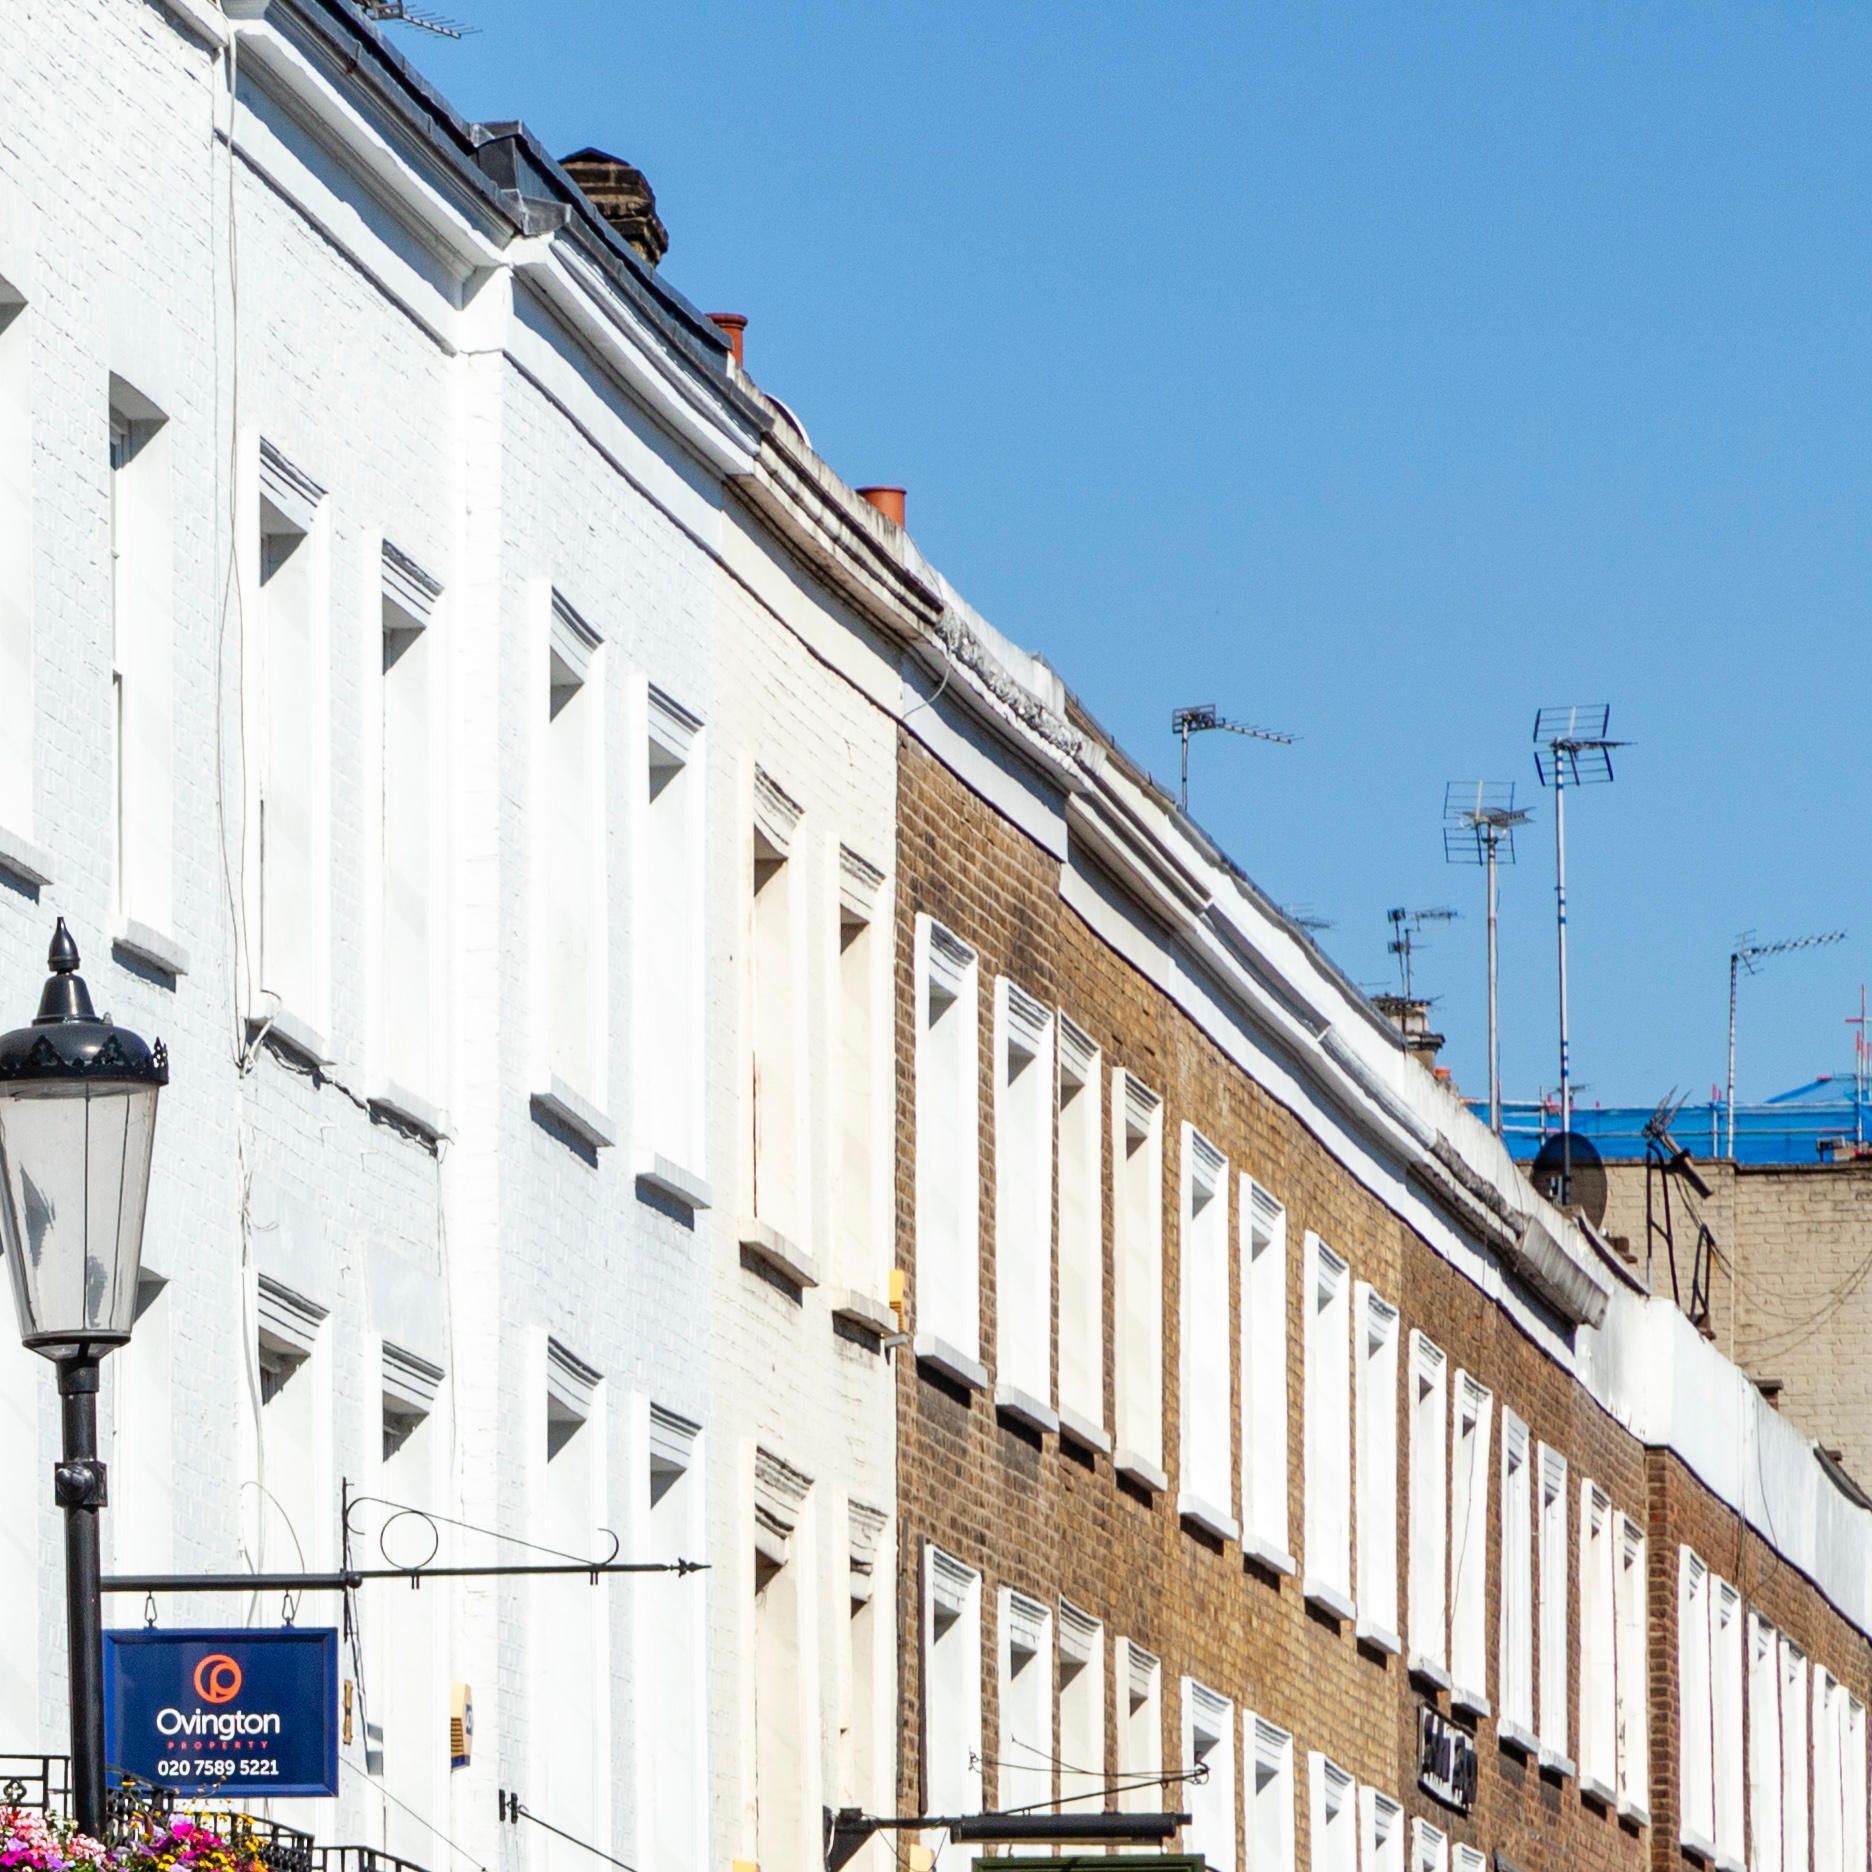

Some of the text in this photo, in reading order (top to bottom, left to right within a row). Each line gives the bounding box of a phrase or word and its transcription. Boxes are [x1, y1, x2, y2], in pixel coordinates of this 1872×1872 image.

[156, 1707, 280, 1742] Ovington
[167, 1740, 270, 1751] PROPERTY
[157, 1759, 279, 1776] 020 7589 5221
